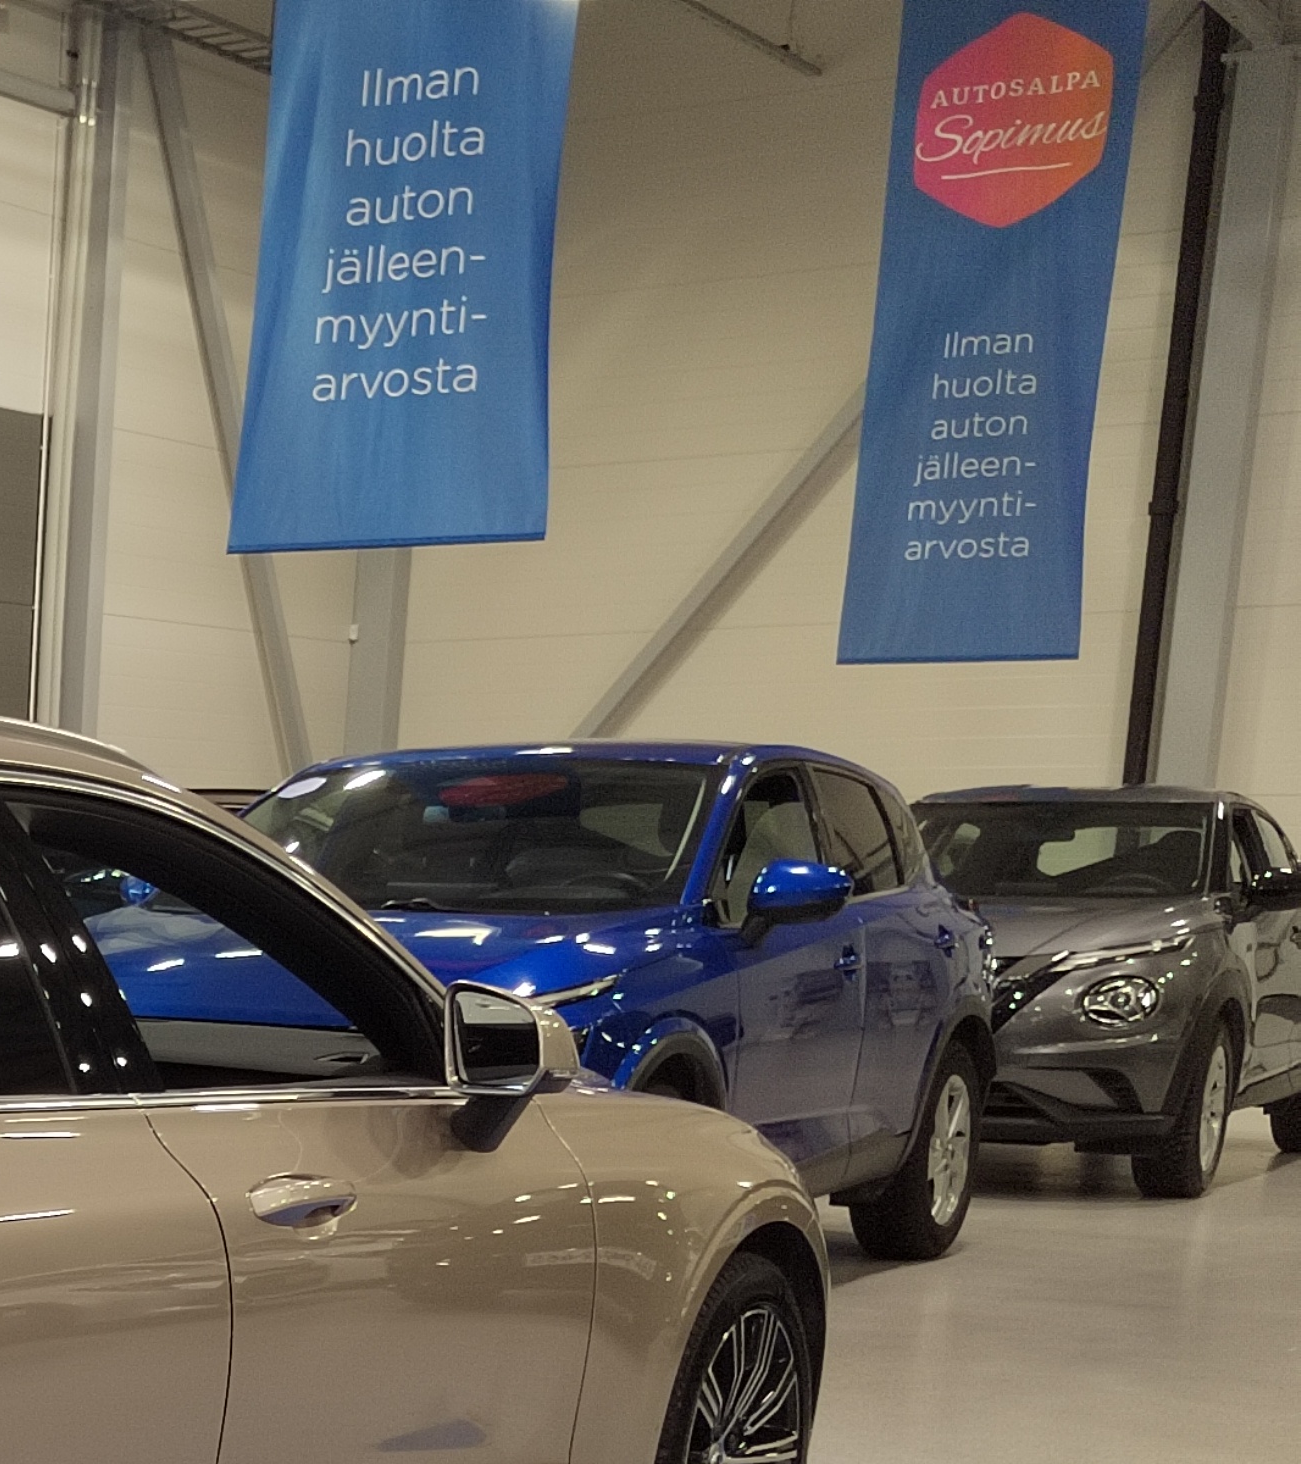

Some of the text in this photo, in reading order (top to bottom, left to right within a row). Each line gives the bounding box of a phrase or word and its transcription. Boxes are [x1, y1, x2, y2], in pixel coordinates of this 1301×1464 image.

[361, 66, 480, 107] Ilman
[930, 70, 1101, 109] AUTOSALPA
[345, 120, 485, 167] huolta
[915, 110, 1108, 165] Sopimus
[345, 185, 474, 227] auton
[321, 243, 487, 294] jälleen-
[314, 295, 488, 350] myynti-
[943, 331, 1034, 359] Ilman
[311, 358, 478, 401] arvosta
[932, 368, 1038, 400] huolta
[930, 412, 1029, 440] auton
[913, 451, 1038, 487] jälleen-
[907, 490, 1038, 525] myynti-
[904, 532, 1030, 561] arvosta
